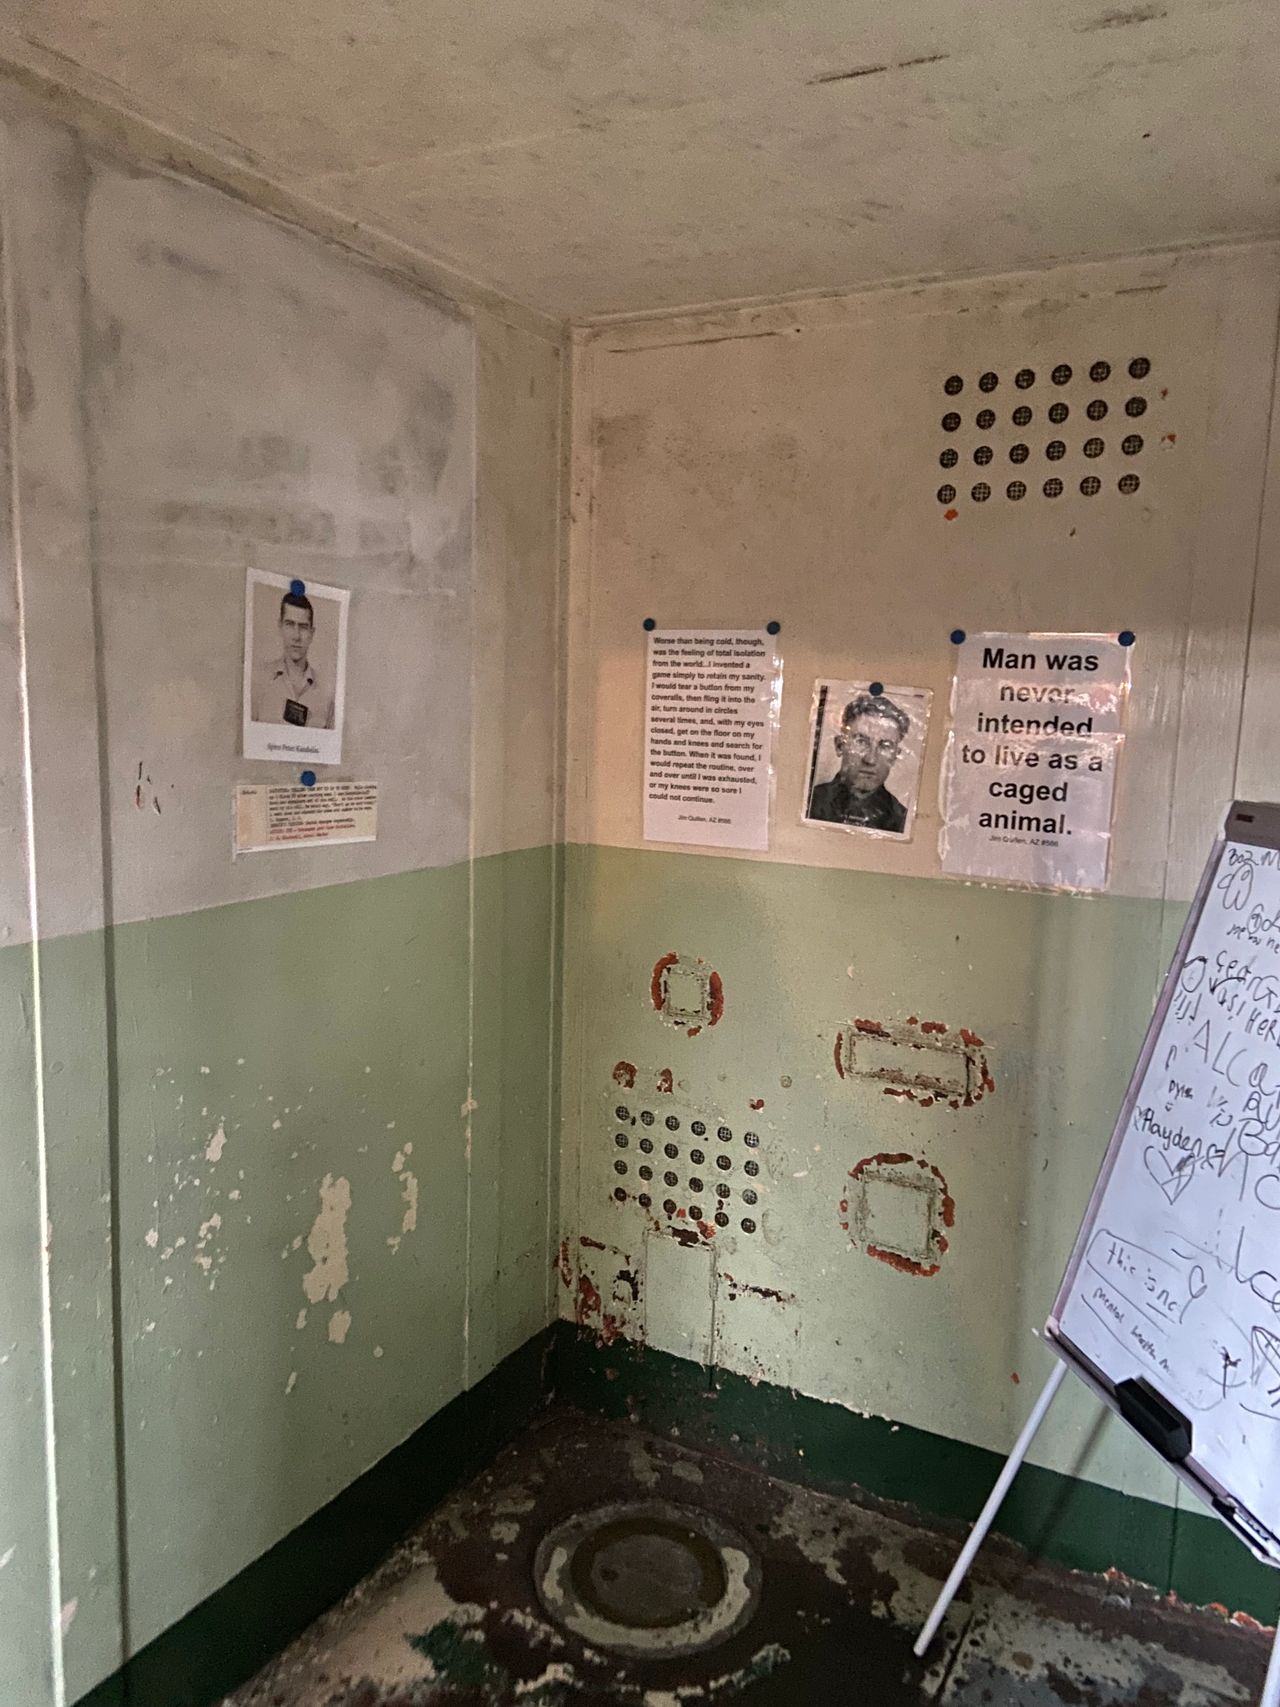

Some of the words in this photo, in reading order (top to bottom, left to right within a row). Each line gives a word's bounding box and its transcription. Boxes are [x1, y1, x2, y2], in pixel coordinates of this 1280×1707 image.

[694, 638, 714, 646] being
[716, 638, 734, 646] cold,
[983, 648, 1036, 669] Man
[1047, 655, 1098, 671] was
[673, 672, 696, 680] simply
[1000, 686, 1074, 704] never
[703, 696, 719, 704] fling
[977, 713, 1092, 737] intended
[677, 728, 688, 736] get
[962, 745, 985, 764] to
[995, 746, 1039, 767] live
[1049, 753, 1077, 770] as
[1089, 756, 1102, 771] a
[672, 762, 694, 770] repeat
[671, 782, 690, 790] knees
[989, 781, 1068, 804] caged
[682, 795, 715, 803] continue.
[979, 811, 1072, 834] animal.
